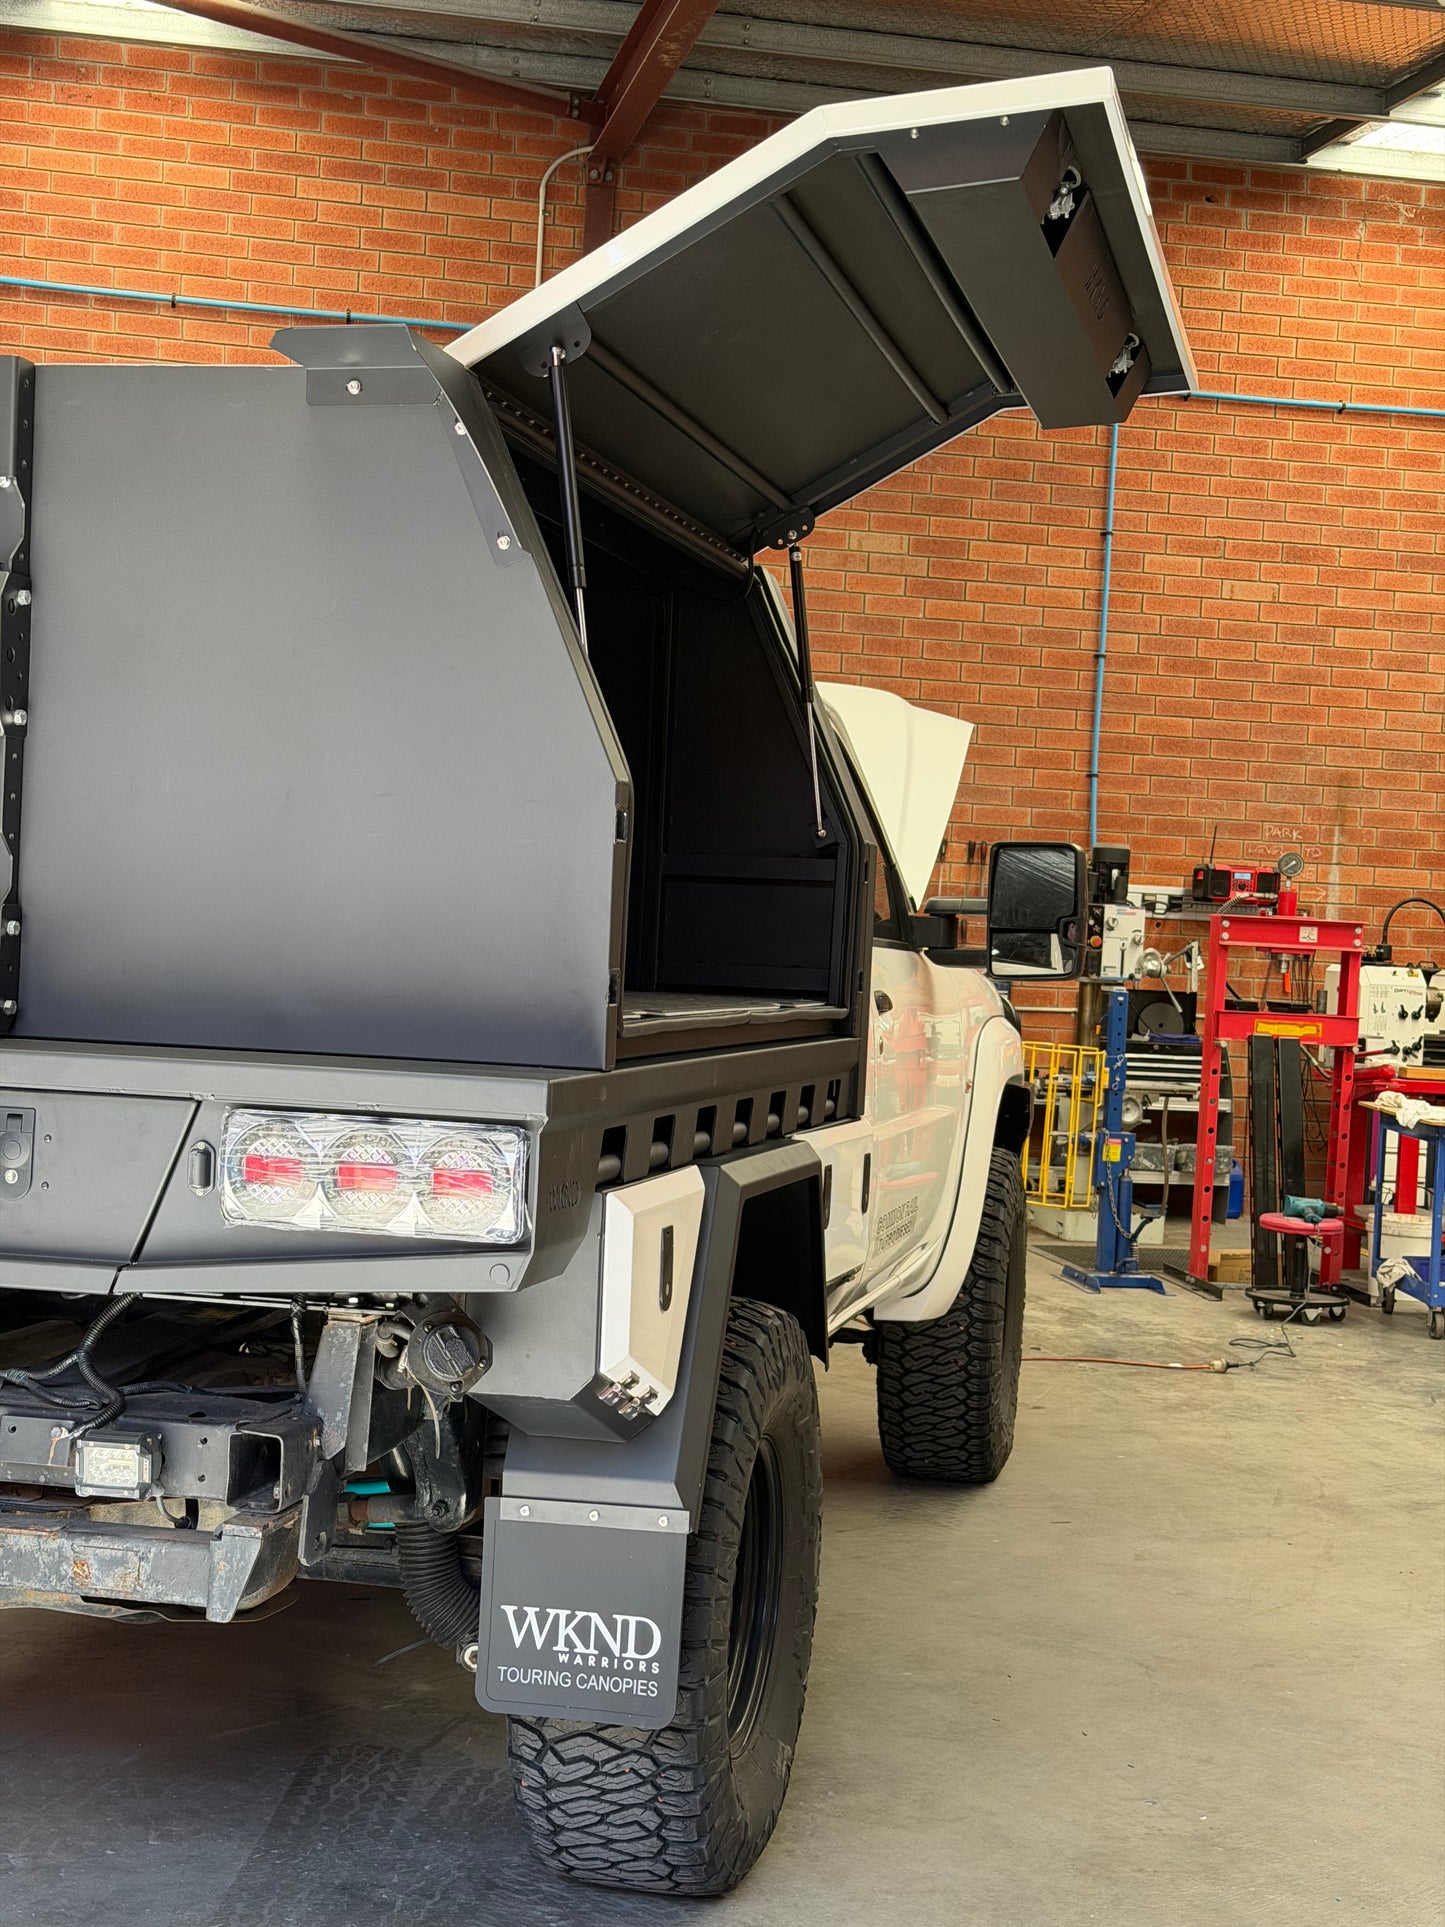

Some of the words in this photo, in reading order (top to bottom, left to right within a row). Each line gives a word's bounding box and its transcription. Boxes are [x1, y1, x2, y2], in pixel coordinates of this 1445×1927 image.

[1264, 825, 1303, 841] PARK
[500, 1605, 662, 1659] WKND
[558, 1652, 660, 1674] WARRIORS
[497, 1666, 571, 1688] TOURING
[575, 1672, 658, 1697] CANOPIES
